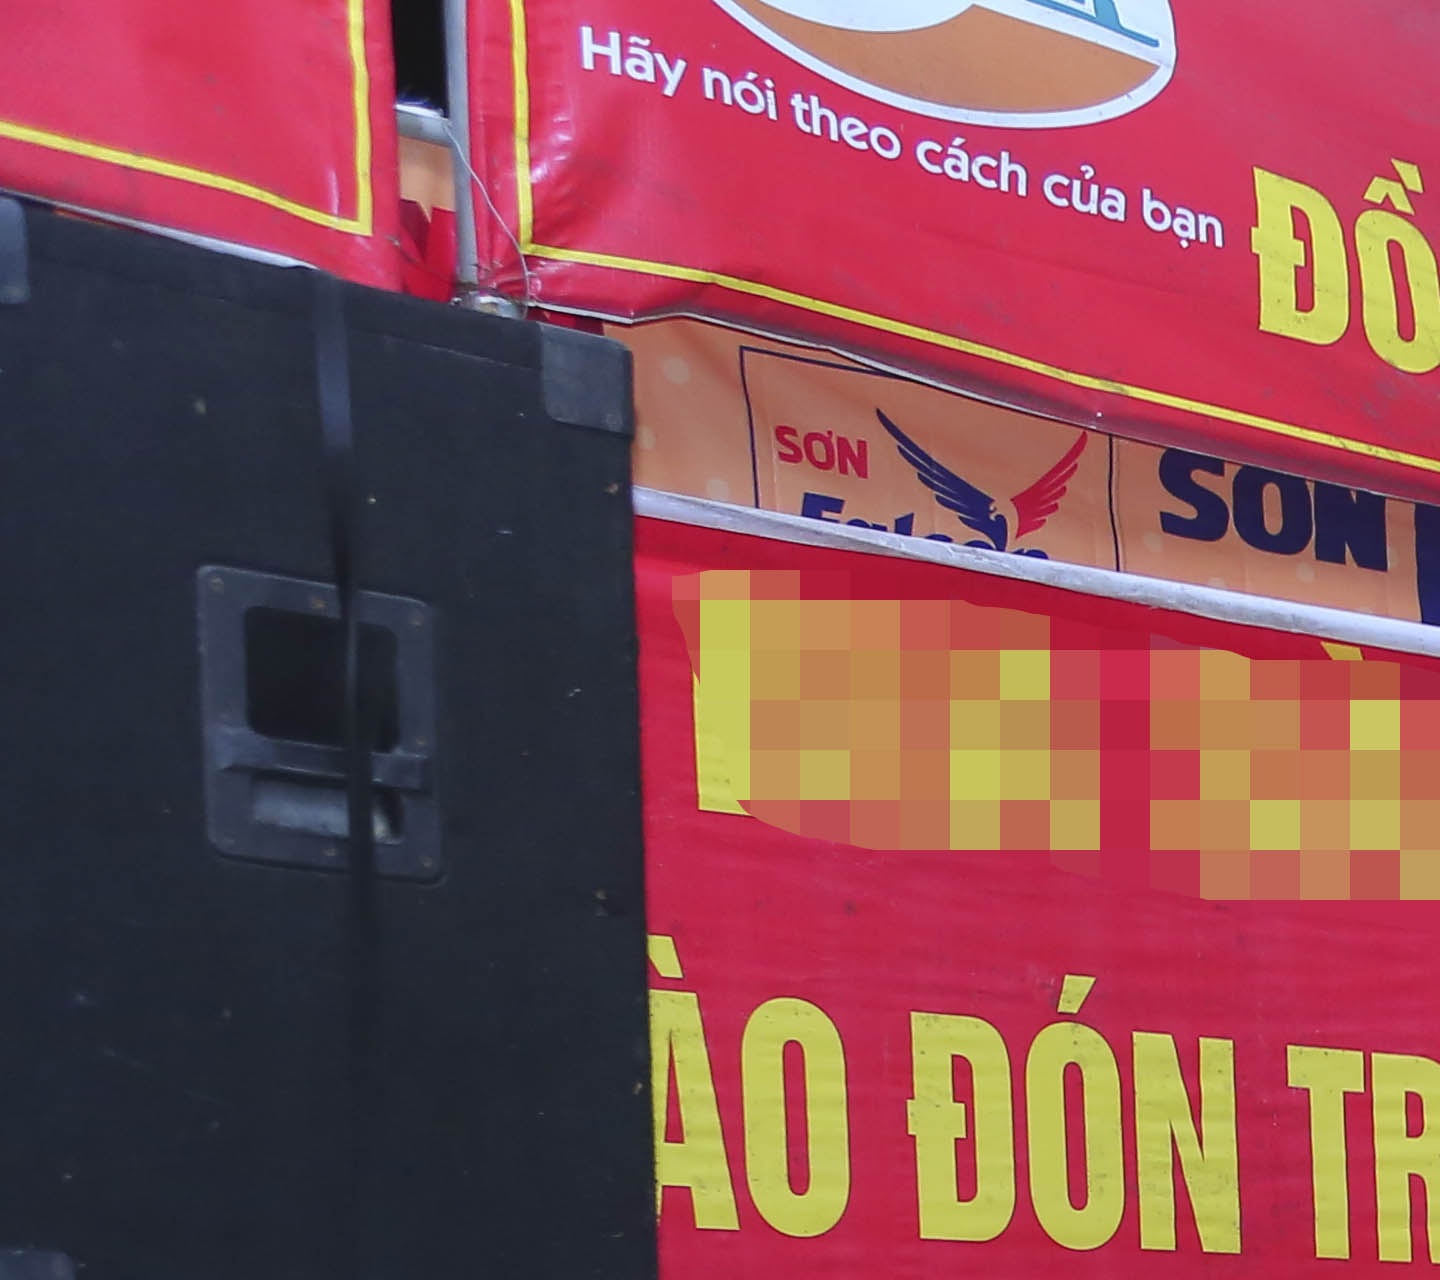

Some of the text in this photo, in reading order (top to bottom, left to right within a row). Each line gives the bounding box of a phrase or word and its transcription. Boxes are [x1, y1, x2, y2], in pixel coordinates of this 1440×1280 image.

[580, 25, 1224, 250] Hãy nói theo cách của bạn
[775, 424, 868, 480] SƠN
[907, 974, 1242, 1254] ĐÓN
